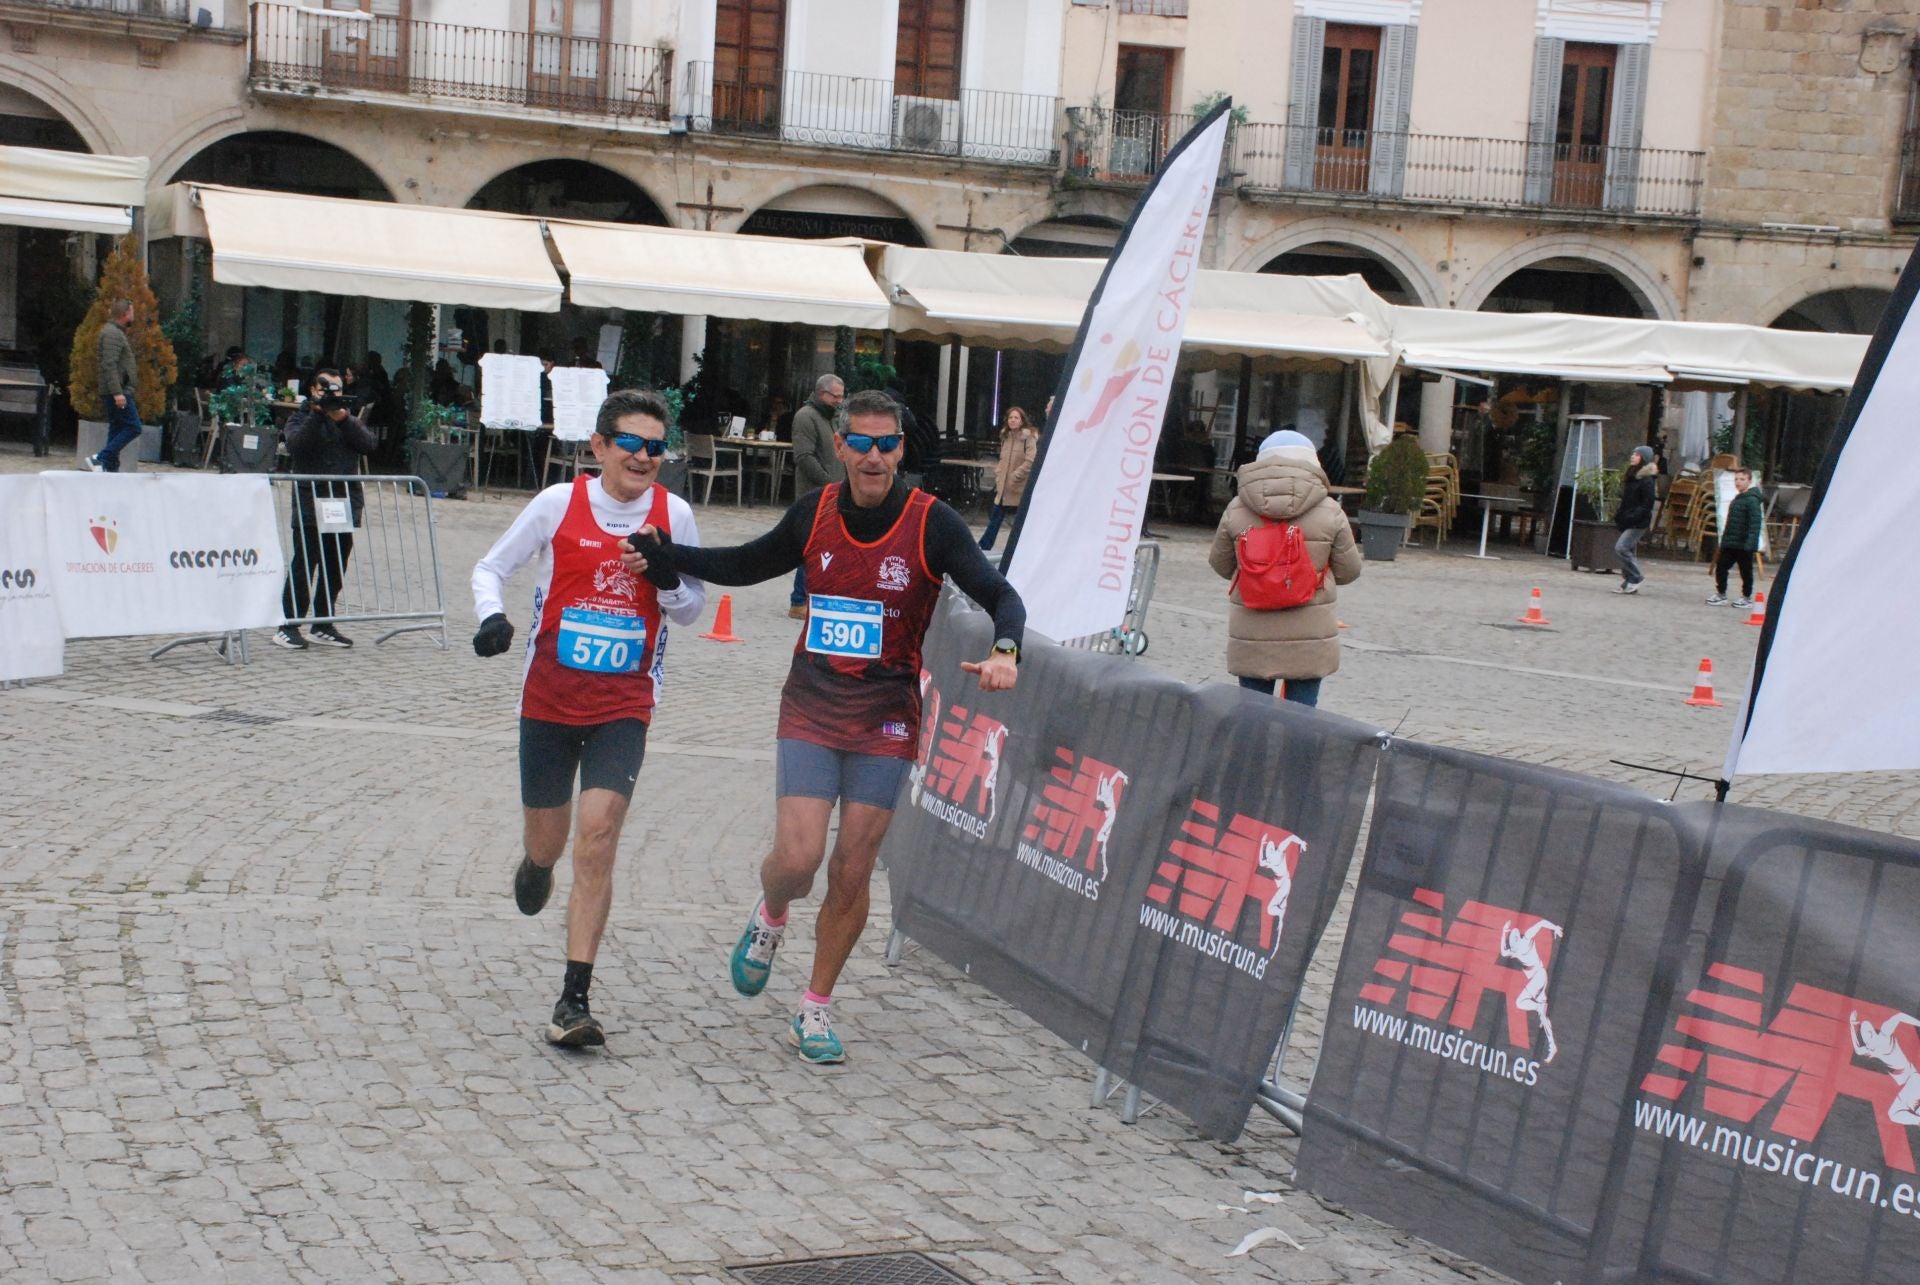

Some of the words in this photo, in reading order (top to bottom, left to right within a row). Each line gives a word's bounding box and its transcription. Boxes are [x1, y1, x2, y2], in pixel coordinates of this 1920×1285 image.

[1097, 396, 1160, 592] DIPUTACIÓN
[1140, 345, 1171, 386] DE
[572, 636, 629, 668] 570
[821, 620, 866, 649] 590
[1016, 841, 1100, 901] www.musicrun.es
[1353, 1004, 1541, 1087] www.musicrun.es
